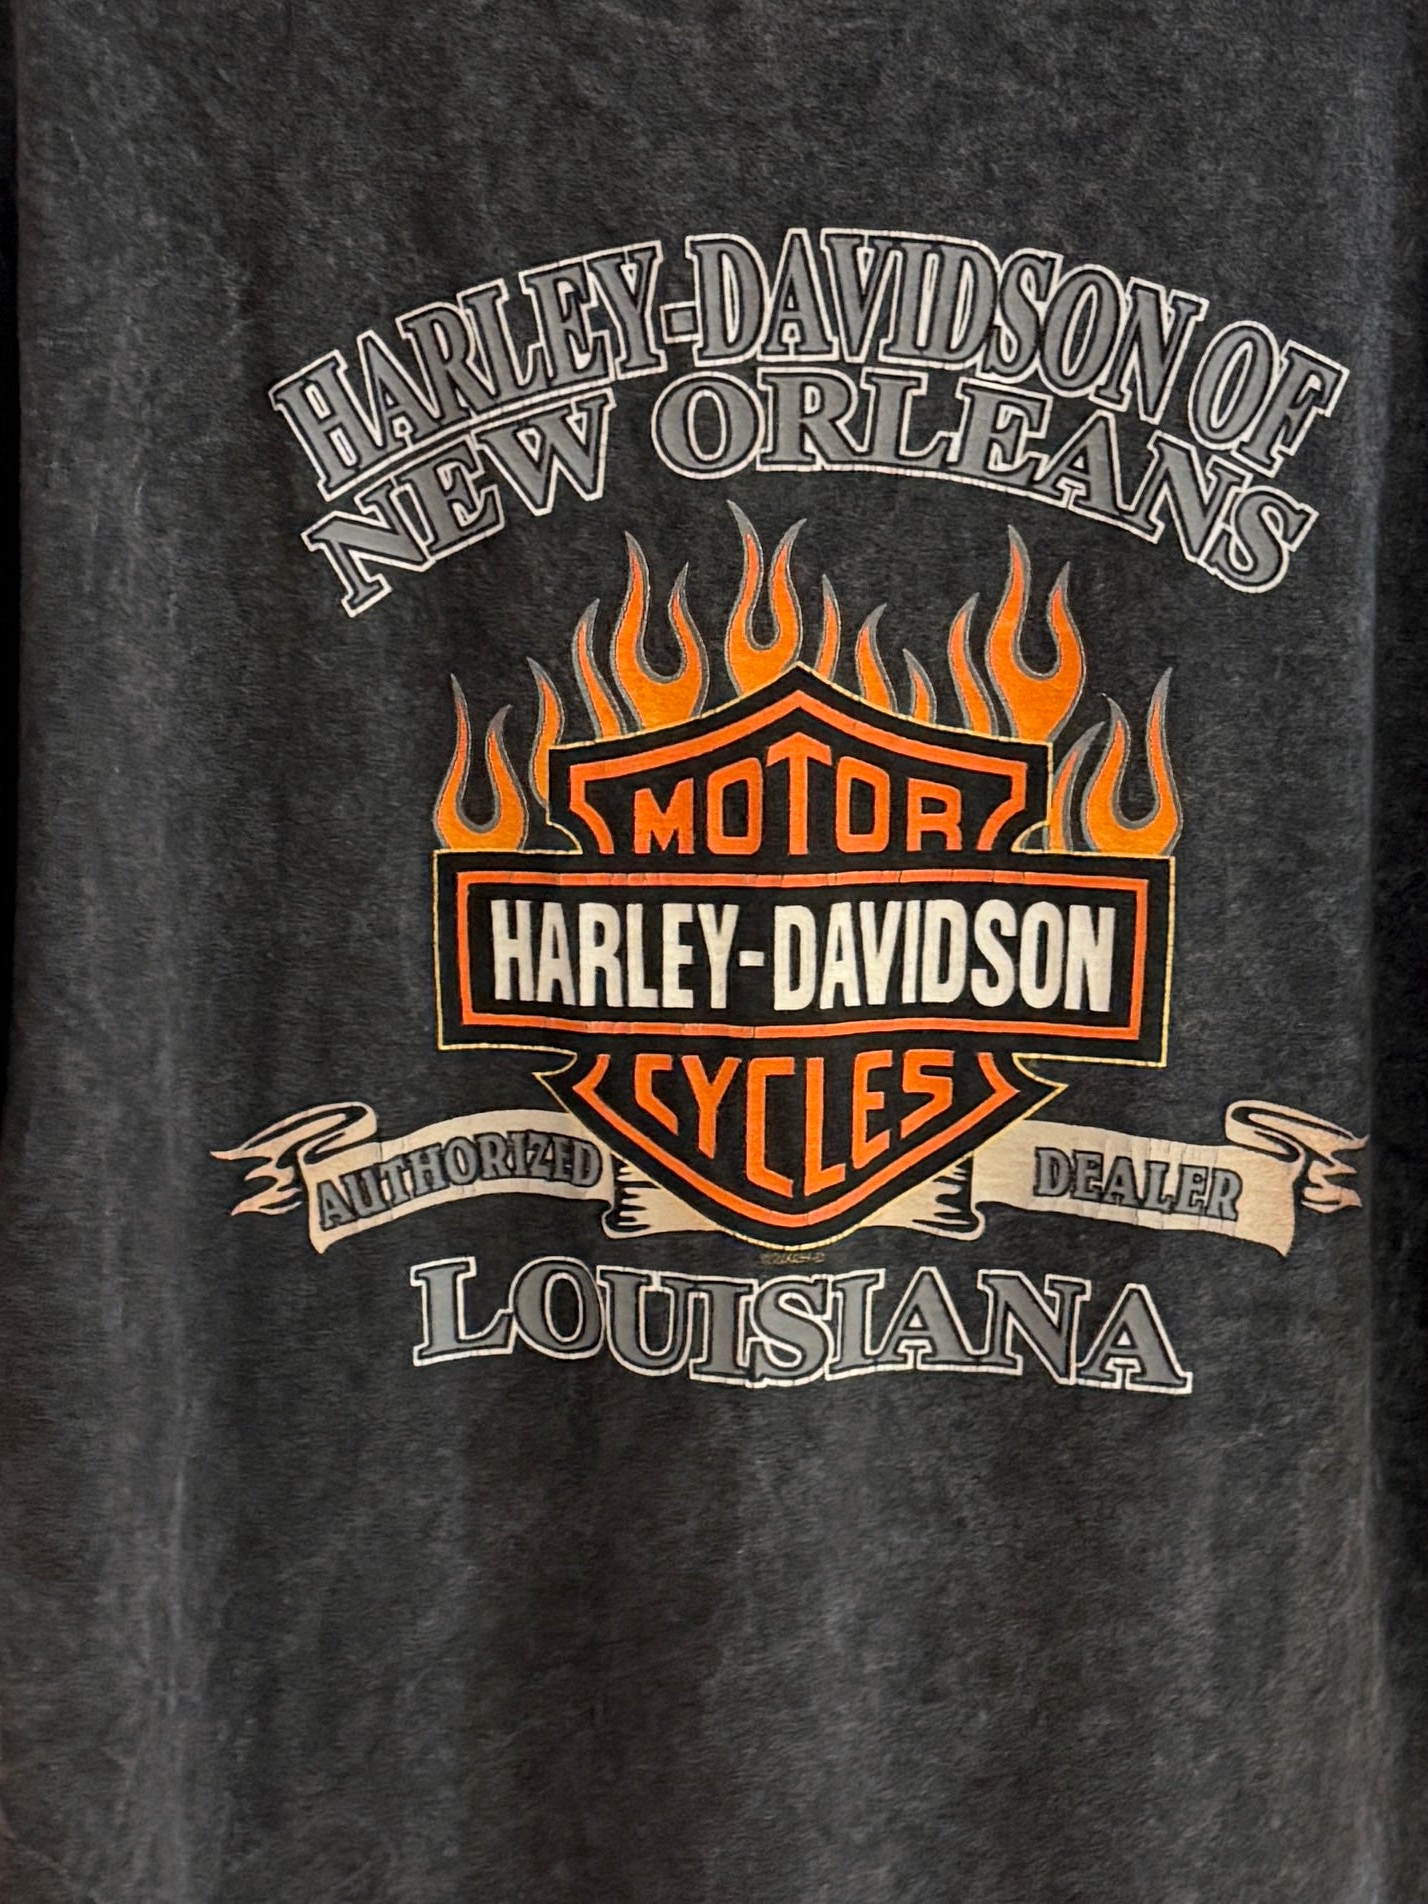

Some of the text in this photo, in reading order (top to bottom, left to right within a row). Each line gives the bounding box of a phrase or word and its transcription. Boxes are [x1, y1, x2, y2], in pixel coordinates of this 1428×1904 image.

[269, 227, 1349, 500] HARLEY-DAVIDSON OF
[309, 365, 1320, 616] NEW ORLEANS
[634, 733, 963, 855] MOTOR
[492, 897, 1114, 1012] HARLEY-DAVIDSON
[316, 1130, 1245, 1230] AUTHORIZED DEALER
[634, 1048, 955, 1198] CYCLES
[412, 1256, 1193, 1395] LOUISIANA
